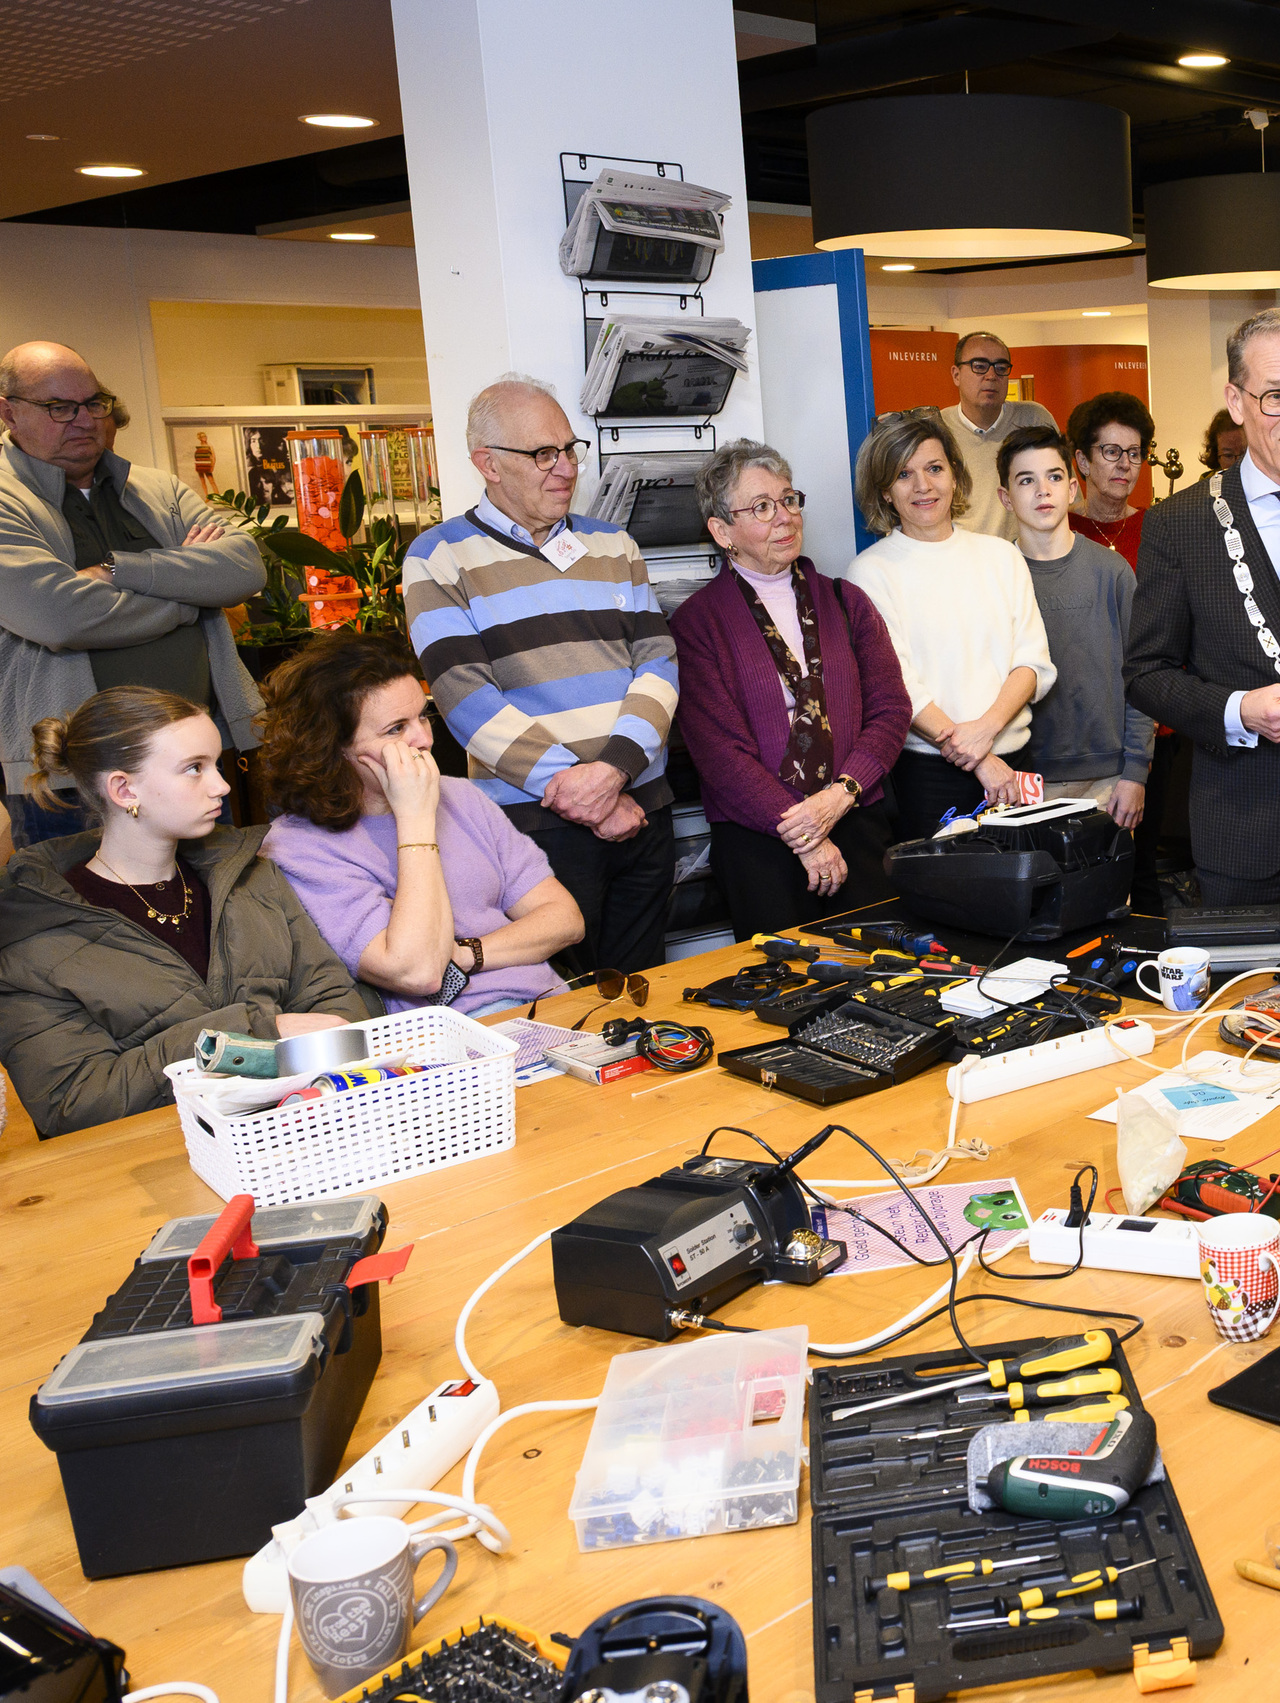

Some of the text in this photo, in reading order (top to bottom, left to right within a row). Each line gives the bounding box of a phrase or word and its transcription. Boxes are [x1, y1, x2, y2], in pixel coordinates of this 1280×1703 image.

[889, 351, 938, 362] INLEVEREN
[1161, 966, 1184, 975] STAR
[1161, 972, 1184, 981] WARS
[929, 1190, 948, 1220] bijdrage
[912, 1219, 929, 1244] Repair
[686, 1233, 717, 1255] Solder Station
[689, 1253, 697, 1261] ST
[1028, 1458, 1082, 1474] BOSCH
